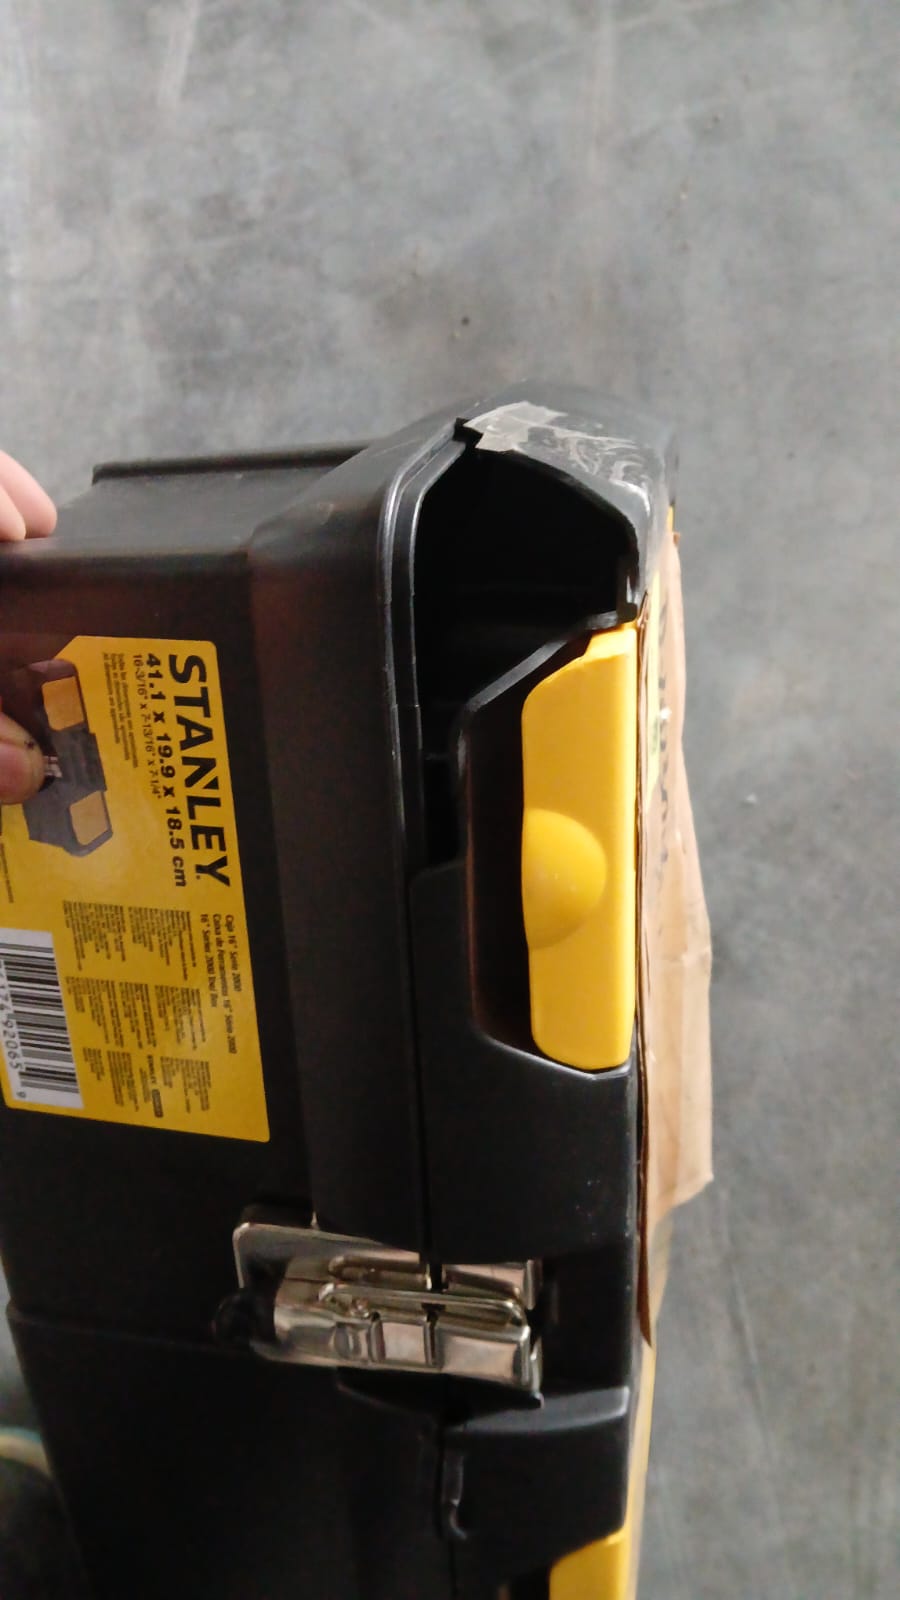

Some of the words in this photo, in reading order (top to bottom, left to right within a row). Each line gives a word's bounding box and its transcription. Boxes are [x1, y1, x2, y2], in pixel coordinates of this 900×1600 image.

[147, 653, 166, 700] 41.1
[153, 711, 165, 723] x
[156, 733, 175, 778] 19.9
[169, 653, 231, 887] STANLEY
[163, 786, 175, 797] x
[166, 806, 184, 849] 18.5
[172, 856, 187, 887] cm
[216, 937, 224, 947] de
[225, 915, 235, 932] Caja
[232, 973, 242, 992] 2000
[205, 956, 215, 974] 2000
[2, 1020, 22, 1069] 92065
